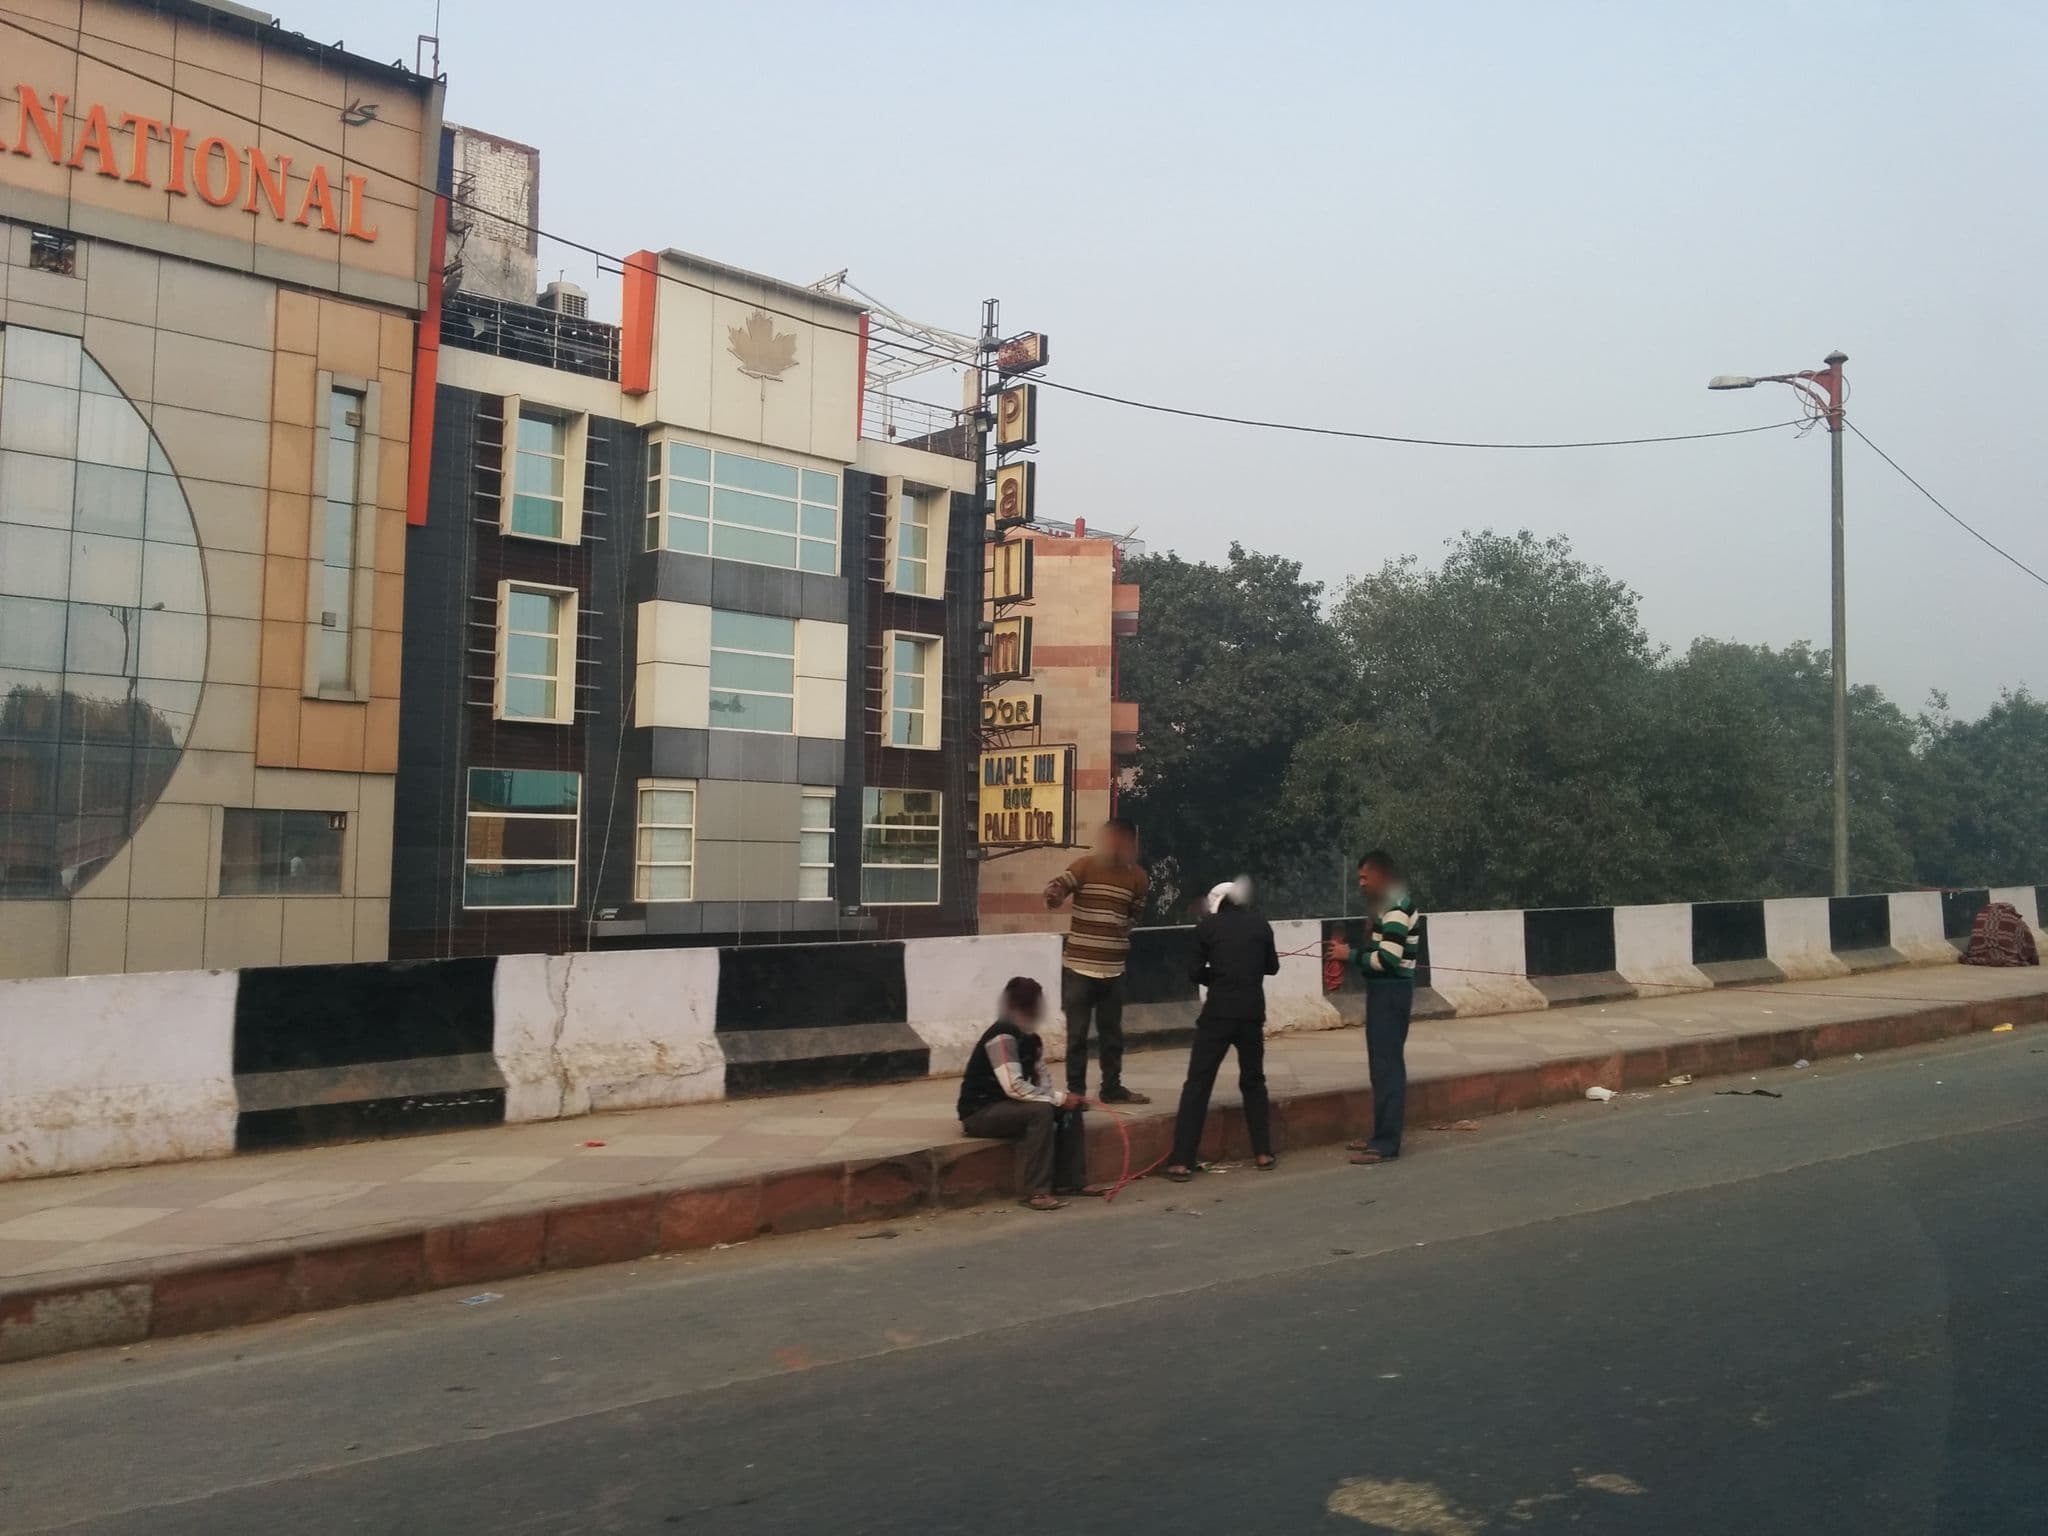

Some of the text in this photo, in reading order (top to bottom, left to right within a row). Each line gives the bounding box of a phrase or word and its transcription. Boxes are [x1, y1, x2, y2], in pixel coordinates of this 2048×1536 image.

[0, 84, 379, 243] NATIONAL
[981, 699, 1030, 726] D'OR
[985, 754, 1056, 786] MAPLE INN
[1003, 788, 1032, 810] NOW
[985, 808, 1055, 841] PALM D'OR
